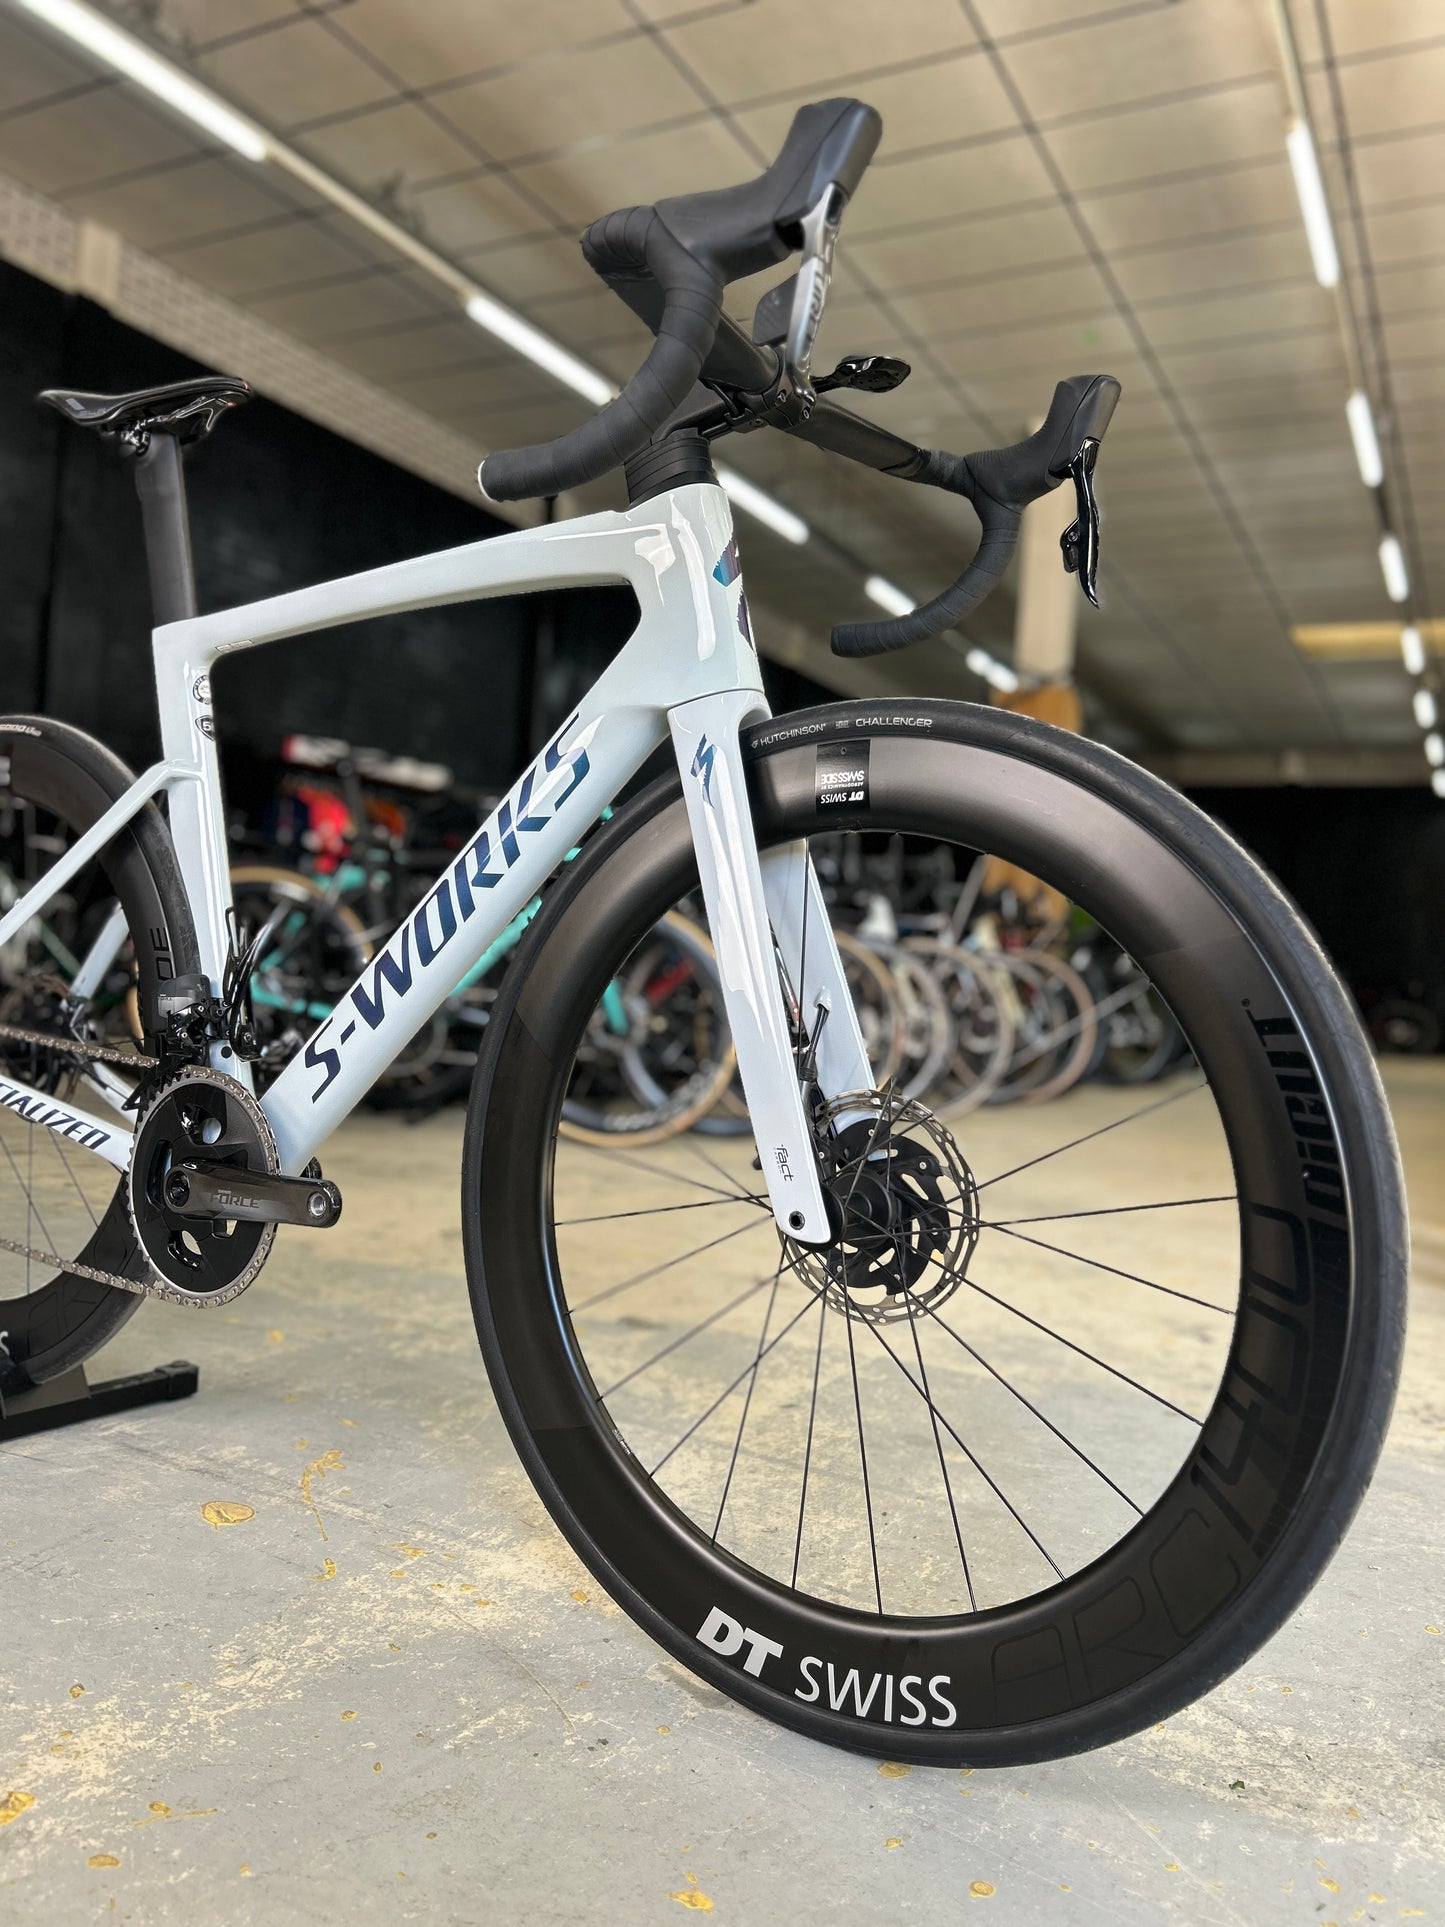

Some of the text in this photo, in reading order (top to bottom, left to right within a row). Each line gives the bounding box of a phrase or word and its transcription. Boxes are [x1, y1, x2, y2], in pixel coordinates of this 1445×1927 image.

[759, 723, 824, 746] HUTCHINSON
[855, 717, 933, 728] CHALLENGER
[820, 790, 865, 804] DT SWISS
[304, 711, 591, 1104] S-WORKS
[776, 1143, 795, 1182] fact
[210, 1193, 260, 1209] FORCE
[695, 1605, 957, 1727] DT SWISS
